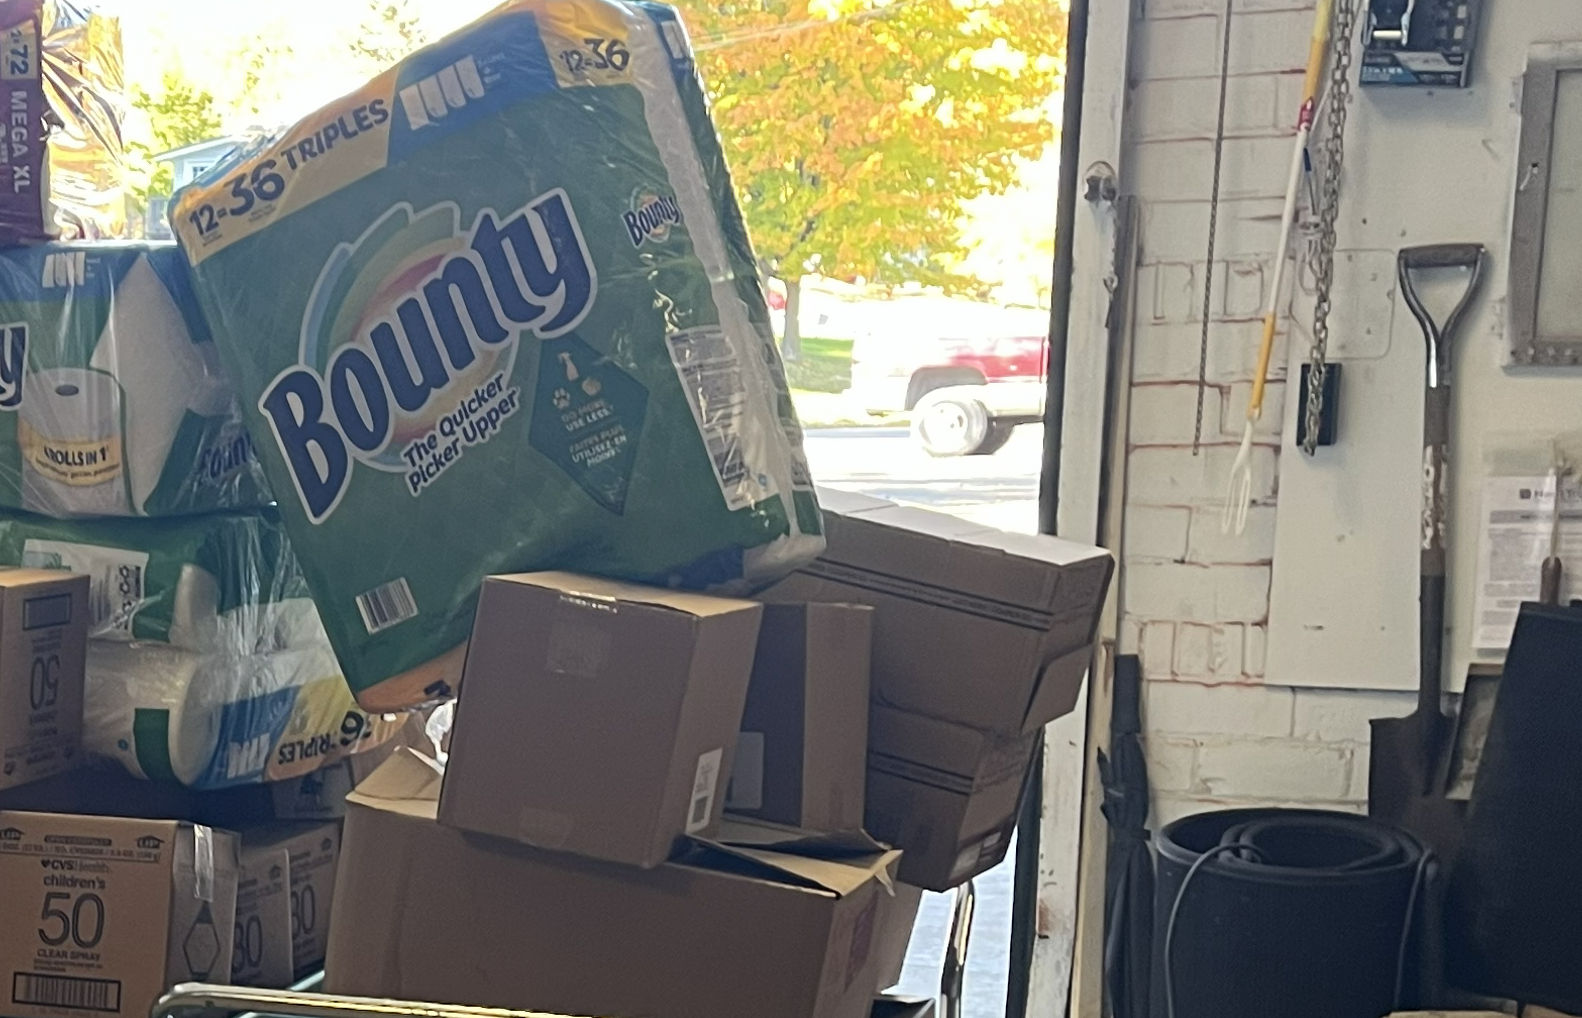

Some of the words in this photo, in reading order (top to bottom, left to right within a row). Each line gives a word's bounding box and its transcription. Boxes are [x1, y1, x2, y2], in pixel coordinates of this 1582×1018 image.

[11, 91, 28, 157] MEGA
[13, 165, 30, 193] XL
[189, 159, 285, 236] 12=36
[281, 98, 389, 170] TRIPLES
[623, 195, 680, 247] Bounty
[260, 189, 595, 521] Bounty
[403, 433, 437, 467] The
[439, 373, 504, 437] Quicker
[408, 438, 460, 493] Picker
[462, 389, 517, 442] Upper
[565, 418, 586, 432] USE
[86, 449, 98, 465] IN
[29, 654, 61, 711] 50
[278, 733, 336, 765] RIPLES
[43, 873, 106, 889] children's
[51, 859, 74, 871] CVS
[37, 891, 106, 949] 50
[36, 949, 68, 959] CLEAR
[70, 951, 101, 962] SPRAY
